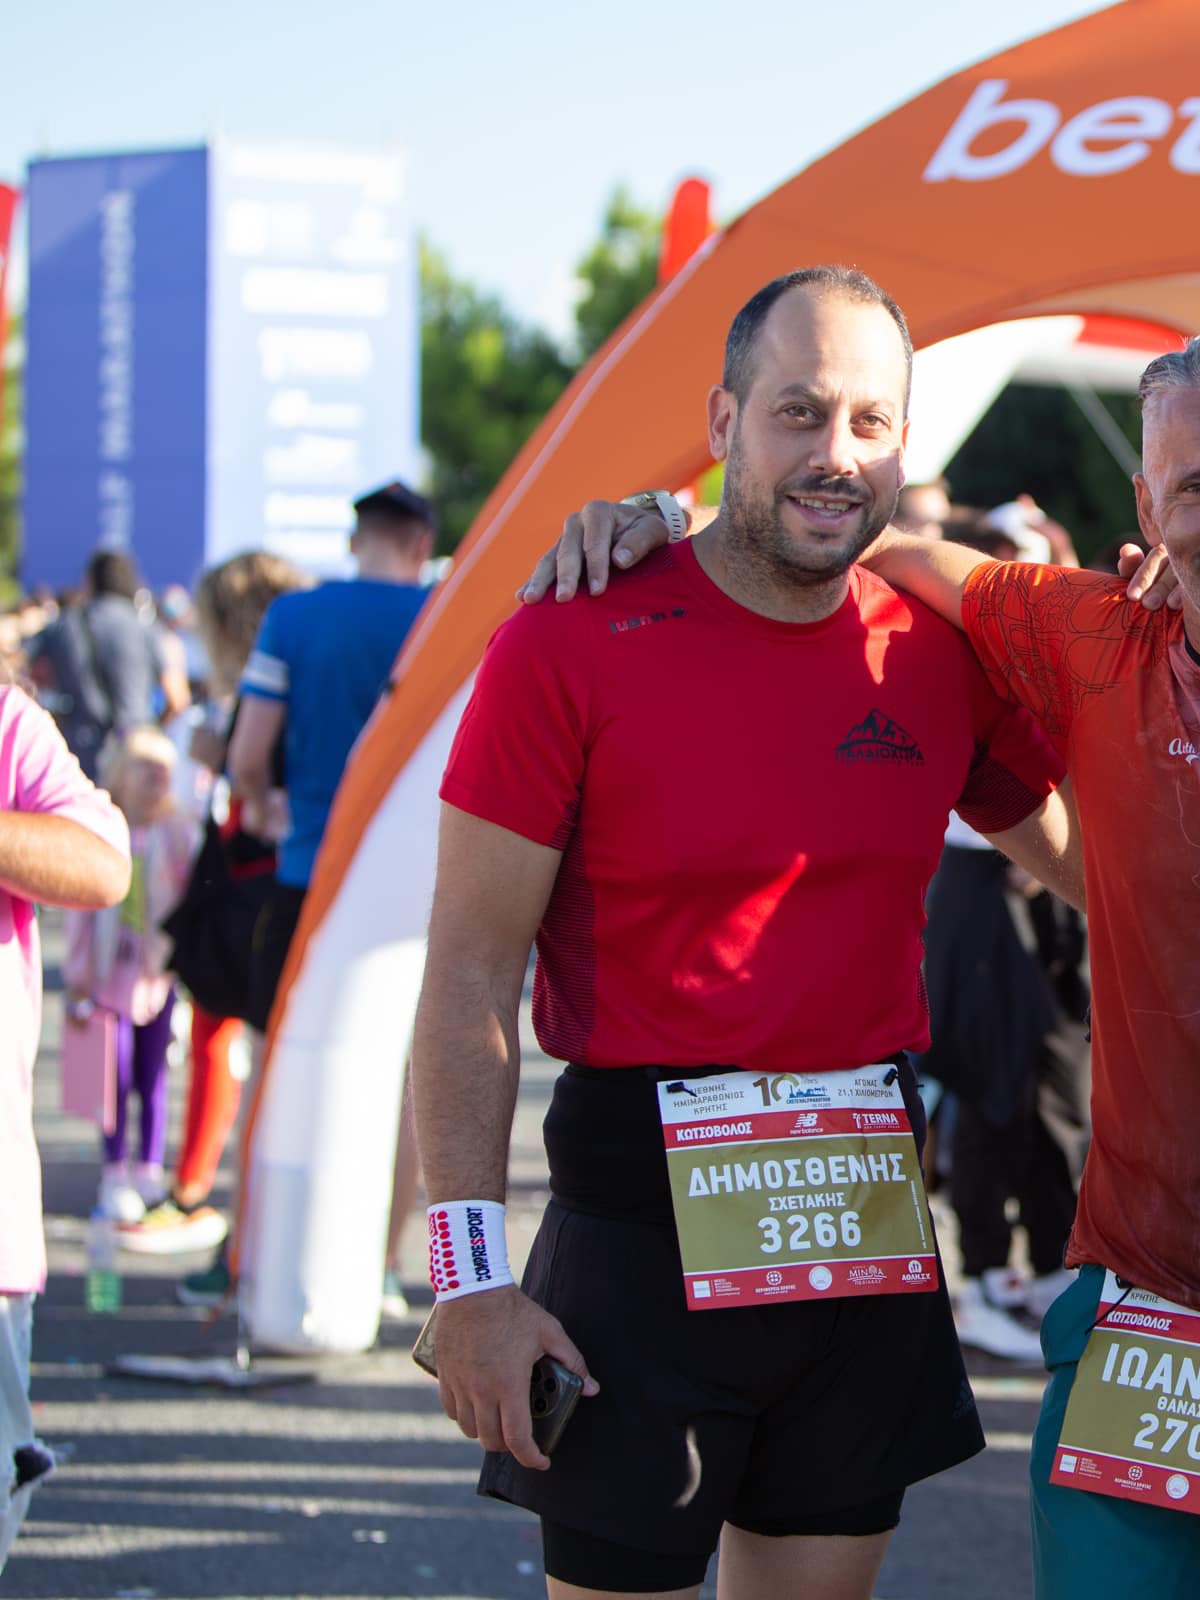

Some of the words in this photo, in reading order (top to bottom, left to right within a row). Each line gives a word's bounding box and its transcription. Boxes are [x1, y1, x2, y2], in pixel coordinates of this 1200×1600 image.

[694, 1103, 728, 1116] ΚΡΗΤΗΣ
[862, 1113, 899, 1124] TERNA
[676, 1121, 753, 1142] ΚΩΤΣΟΒΟΛΟΣ
[688, 1153, 906, 1197] ΔΗΜΟΣΘΕΝΗΣ
[768, 1192, 846, 1211] ΣΧΕΤΑΚΗΣ
[757, 1211, 862, 1253] 3266
[466, 1207, 492, 1282] COMPRESSPORT
[1130, 1292, 1160, 1303] ΚΡΗΤΗΣ
[1106, 1310, 1172, 1331] ΚΩΤΣΟΒΟΛΟΣ
